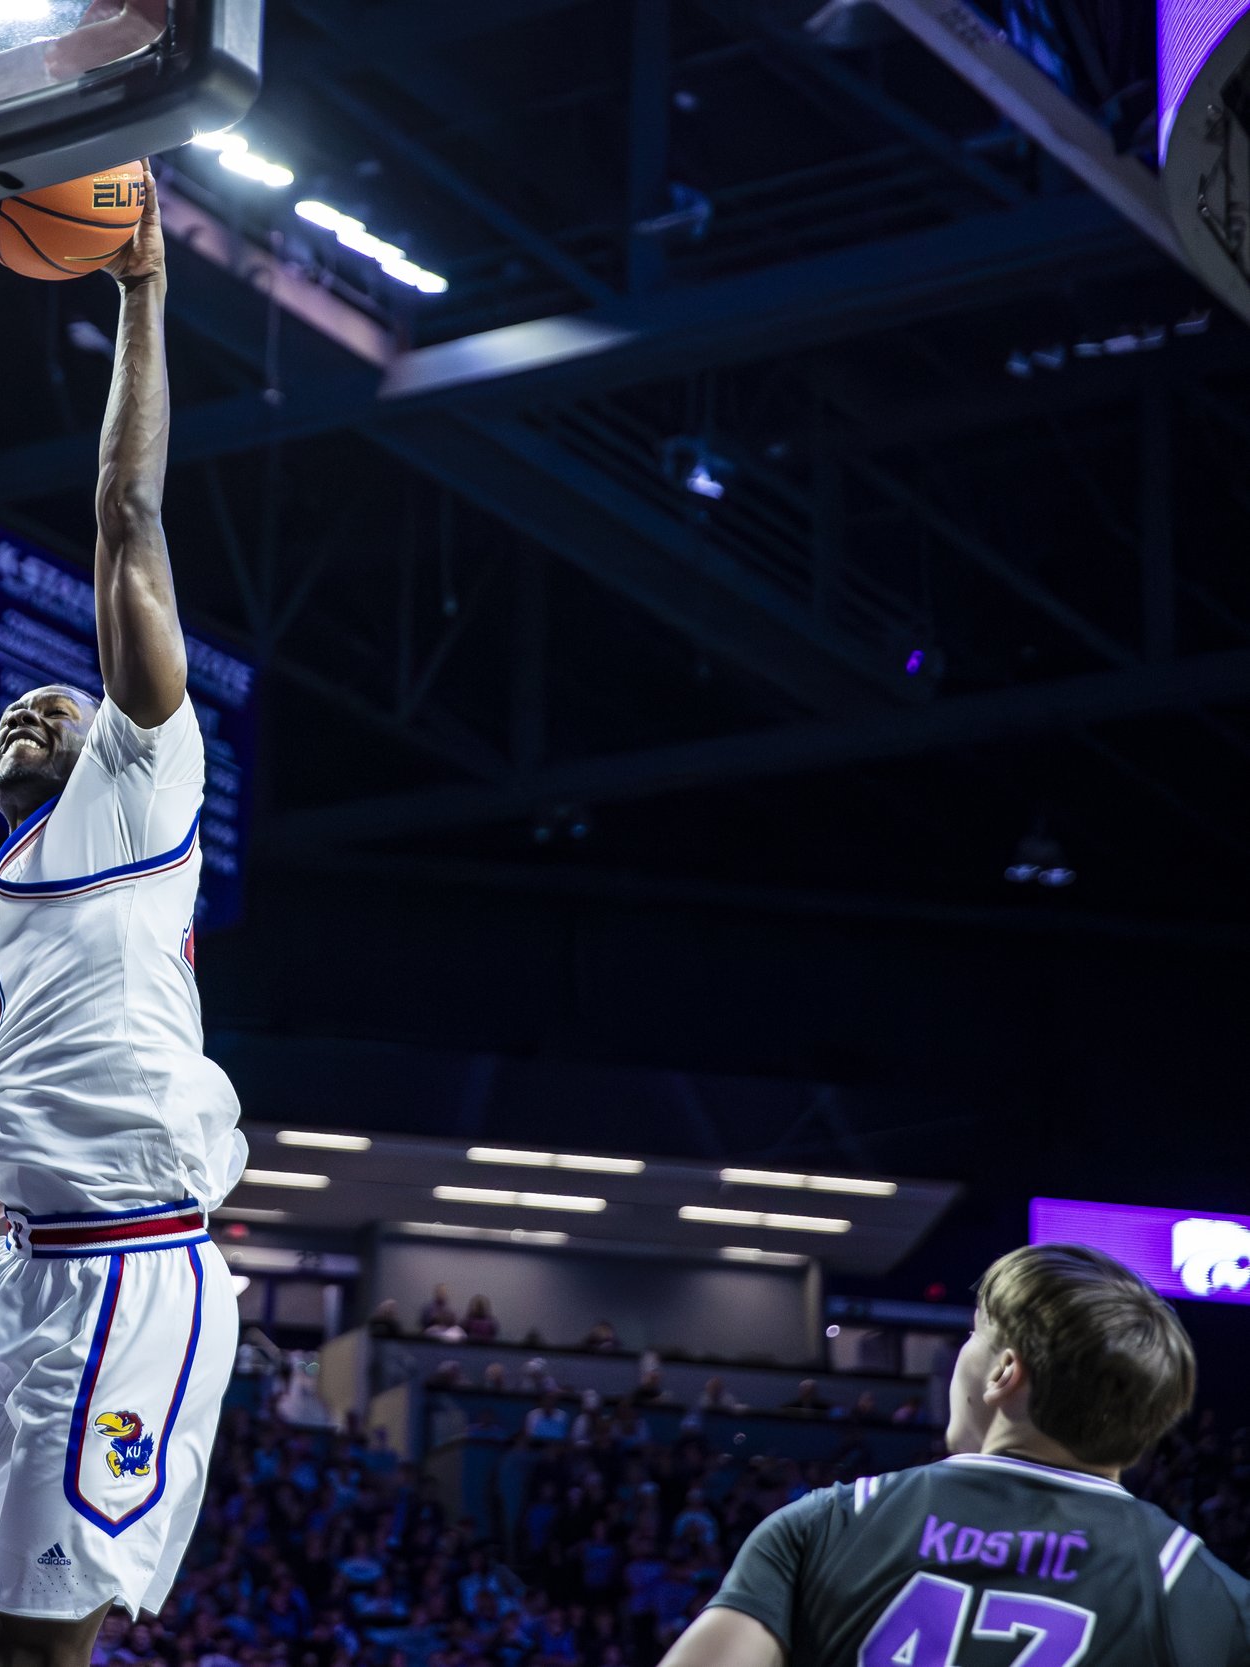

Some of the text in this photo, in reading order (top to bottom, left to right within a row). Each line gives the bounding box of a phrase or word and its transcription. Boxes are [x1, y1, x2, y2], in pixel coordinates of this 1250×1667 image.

[126, 1445, 142, 1458] KU
[37, 1556, 72, 1566] adidas
[857, 1570, 1097, 1667] 47
